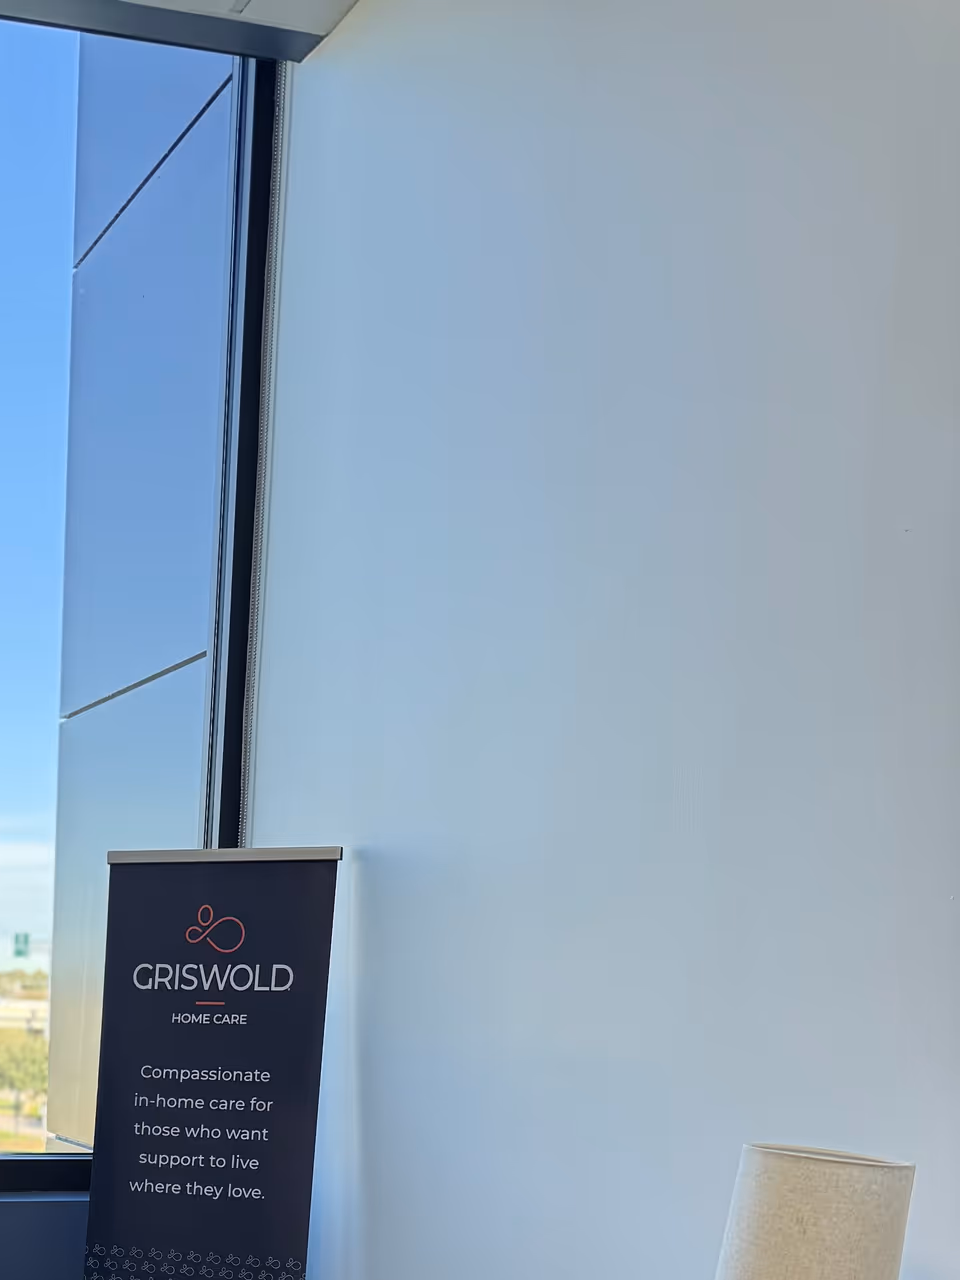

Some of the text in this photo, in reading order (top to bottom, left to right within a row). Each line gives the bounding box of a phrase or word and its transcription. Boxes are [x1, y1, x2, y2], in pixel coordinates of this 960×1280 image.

[132, 963, 294, 992] GRISWOLD
[171, 1012, 248, 1026] HOME CARE
[140, 1064, 271, 1083] Compassionate
[134, 1092, 274, 1112] in-home care for
[133, 1121, 269, 1141] those who want
[138, 1153, 260, 1170] support to live
[129, 1178, 265, 1200] where they love.
